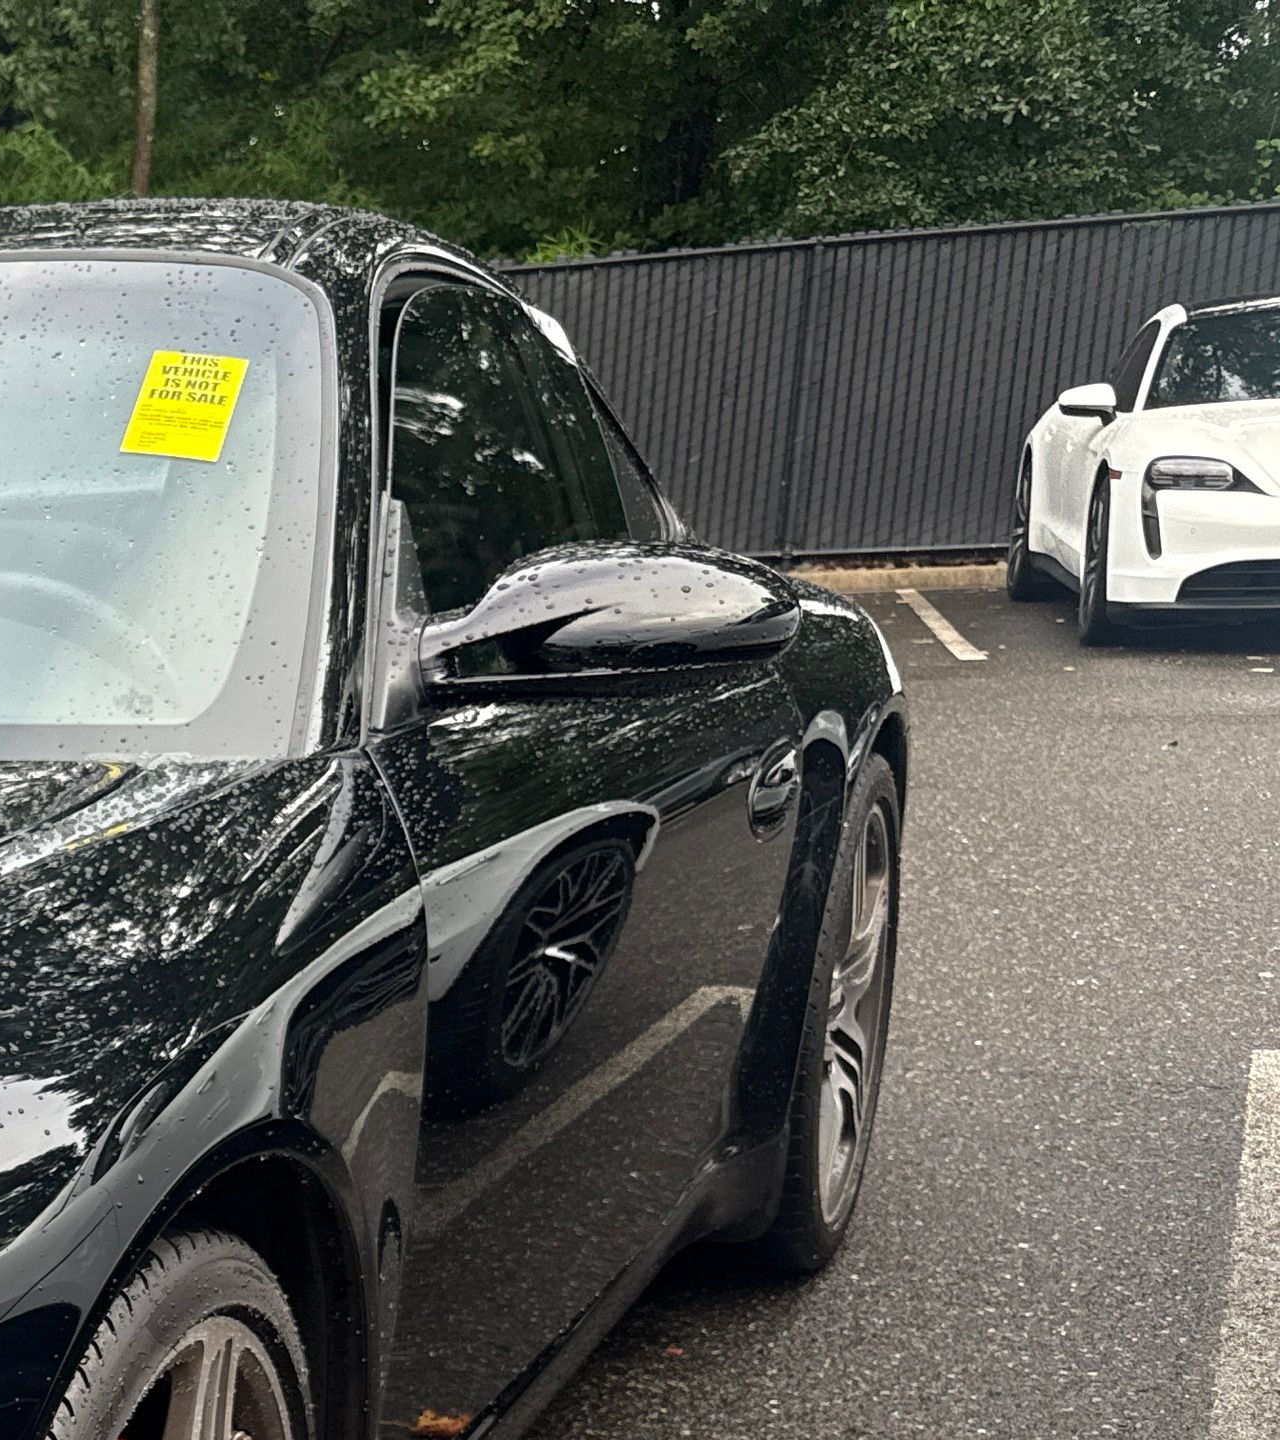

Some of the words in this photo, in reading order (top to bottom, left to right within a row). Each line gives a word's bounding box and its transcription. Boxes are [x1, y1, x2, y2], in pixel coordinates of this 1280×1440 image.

[181, 355, 220, 367] THIS
[161, 365, 231, 381] VEHICLE
[163, 378, 182, 388] IS
[184, 379, 221, 392] NOT
[148, 388, 182, 401] FOR
[185, 392, 228, 406] SALE
